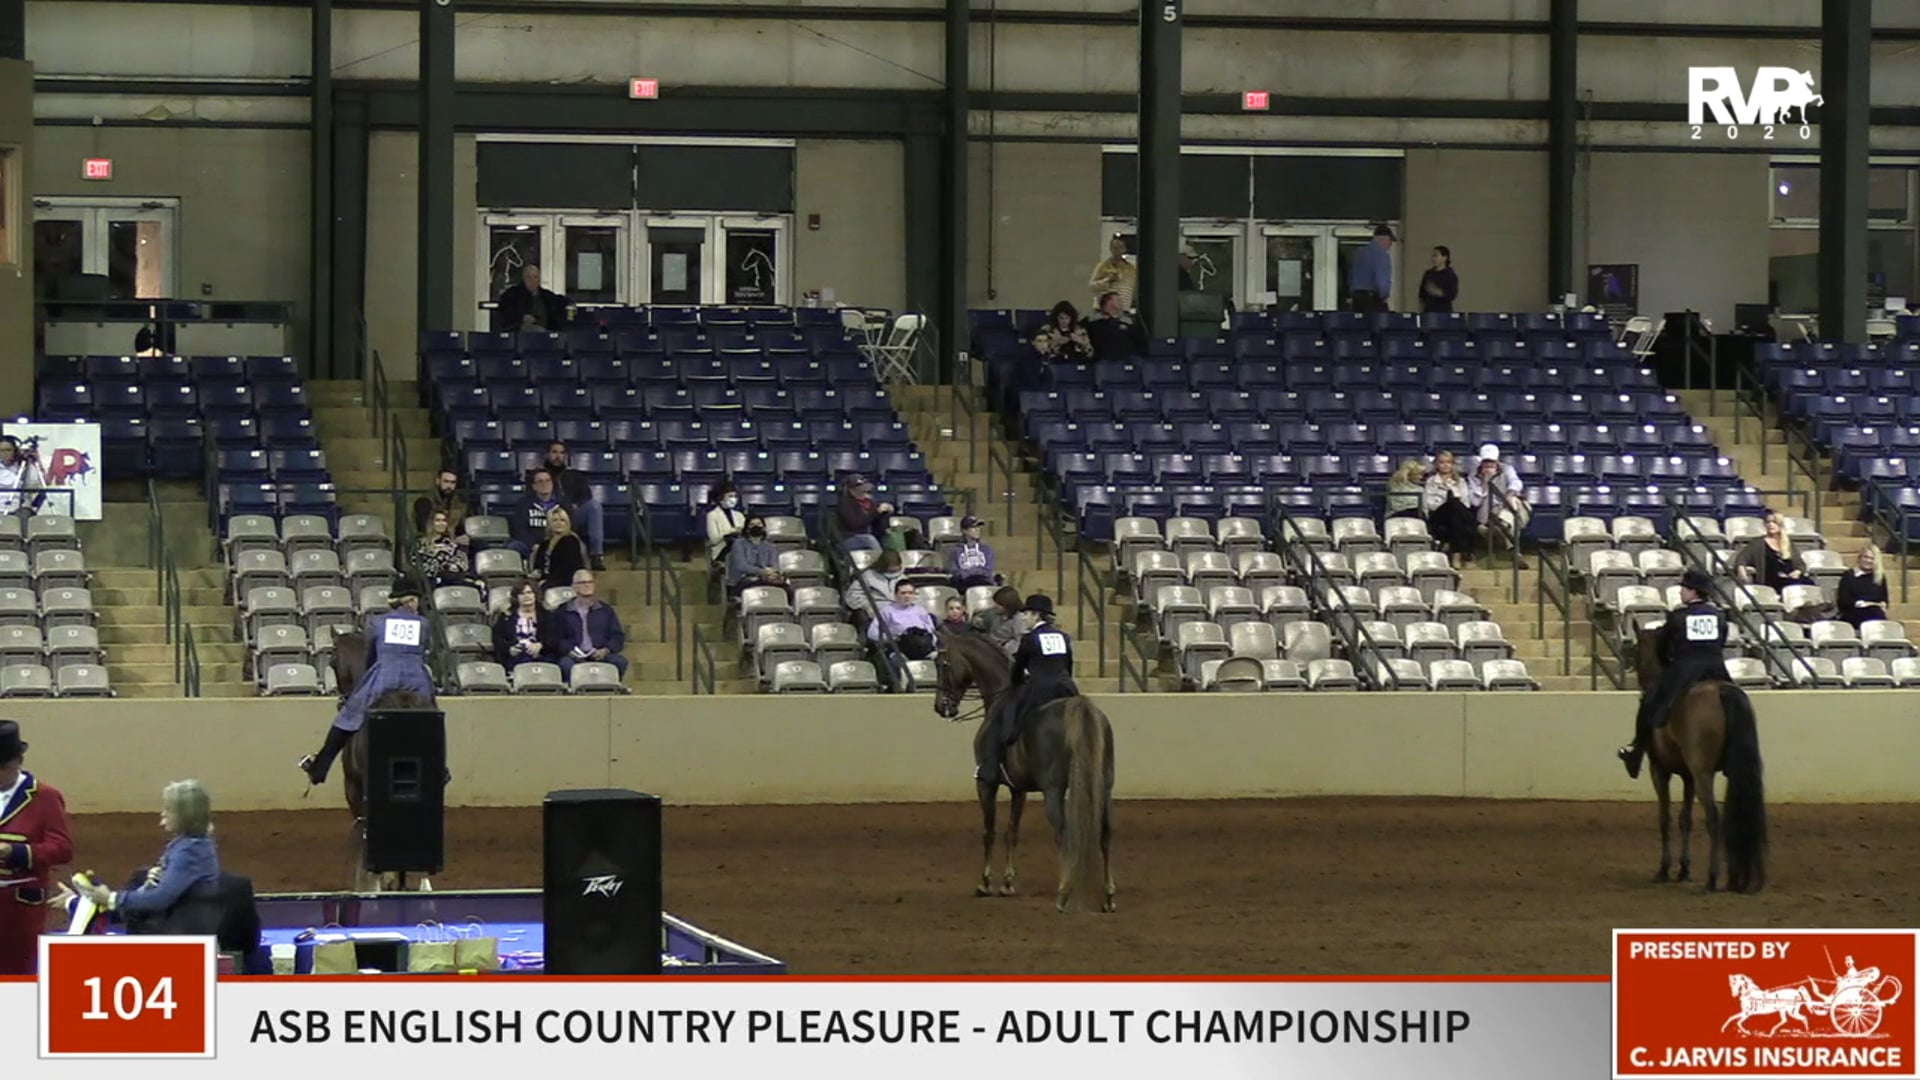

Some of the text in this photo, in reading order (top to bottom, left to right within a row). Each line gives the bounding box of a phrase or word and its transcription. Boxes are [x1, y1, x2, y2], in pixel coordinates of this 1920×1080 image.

[1163, 5, 1176, 22] 5
[633, 79, 656, 97] EXIT
[1246, 91, 1268, 109] EXIT
[86, 160, 110, 178] EXIT
[391, 623, 415, 641] 408
[1691, 617, 1714, 636] 400
